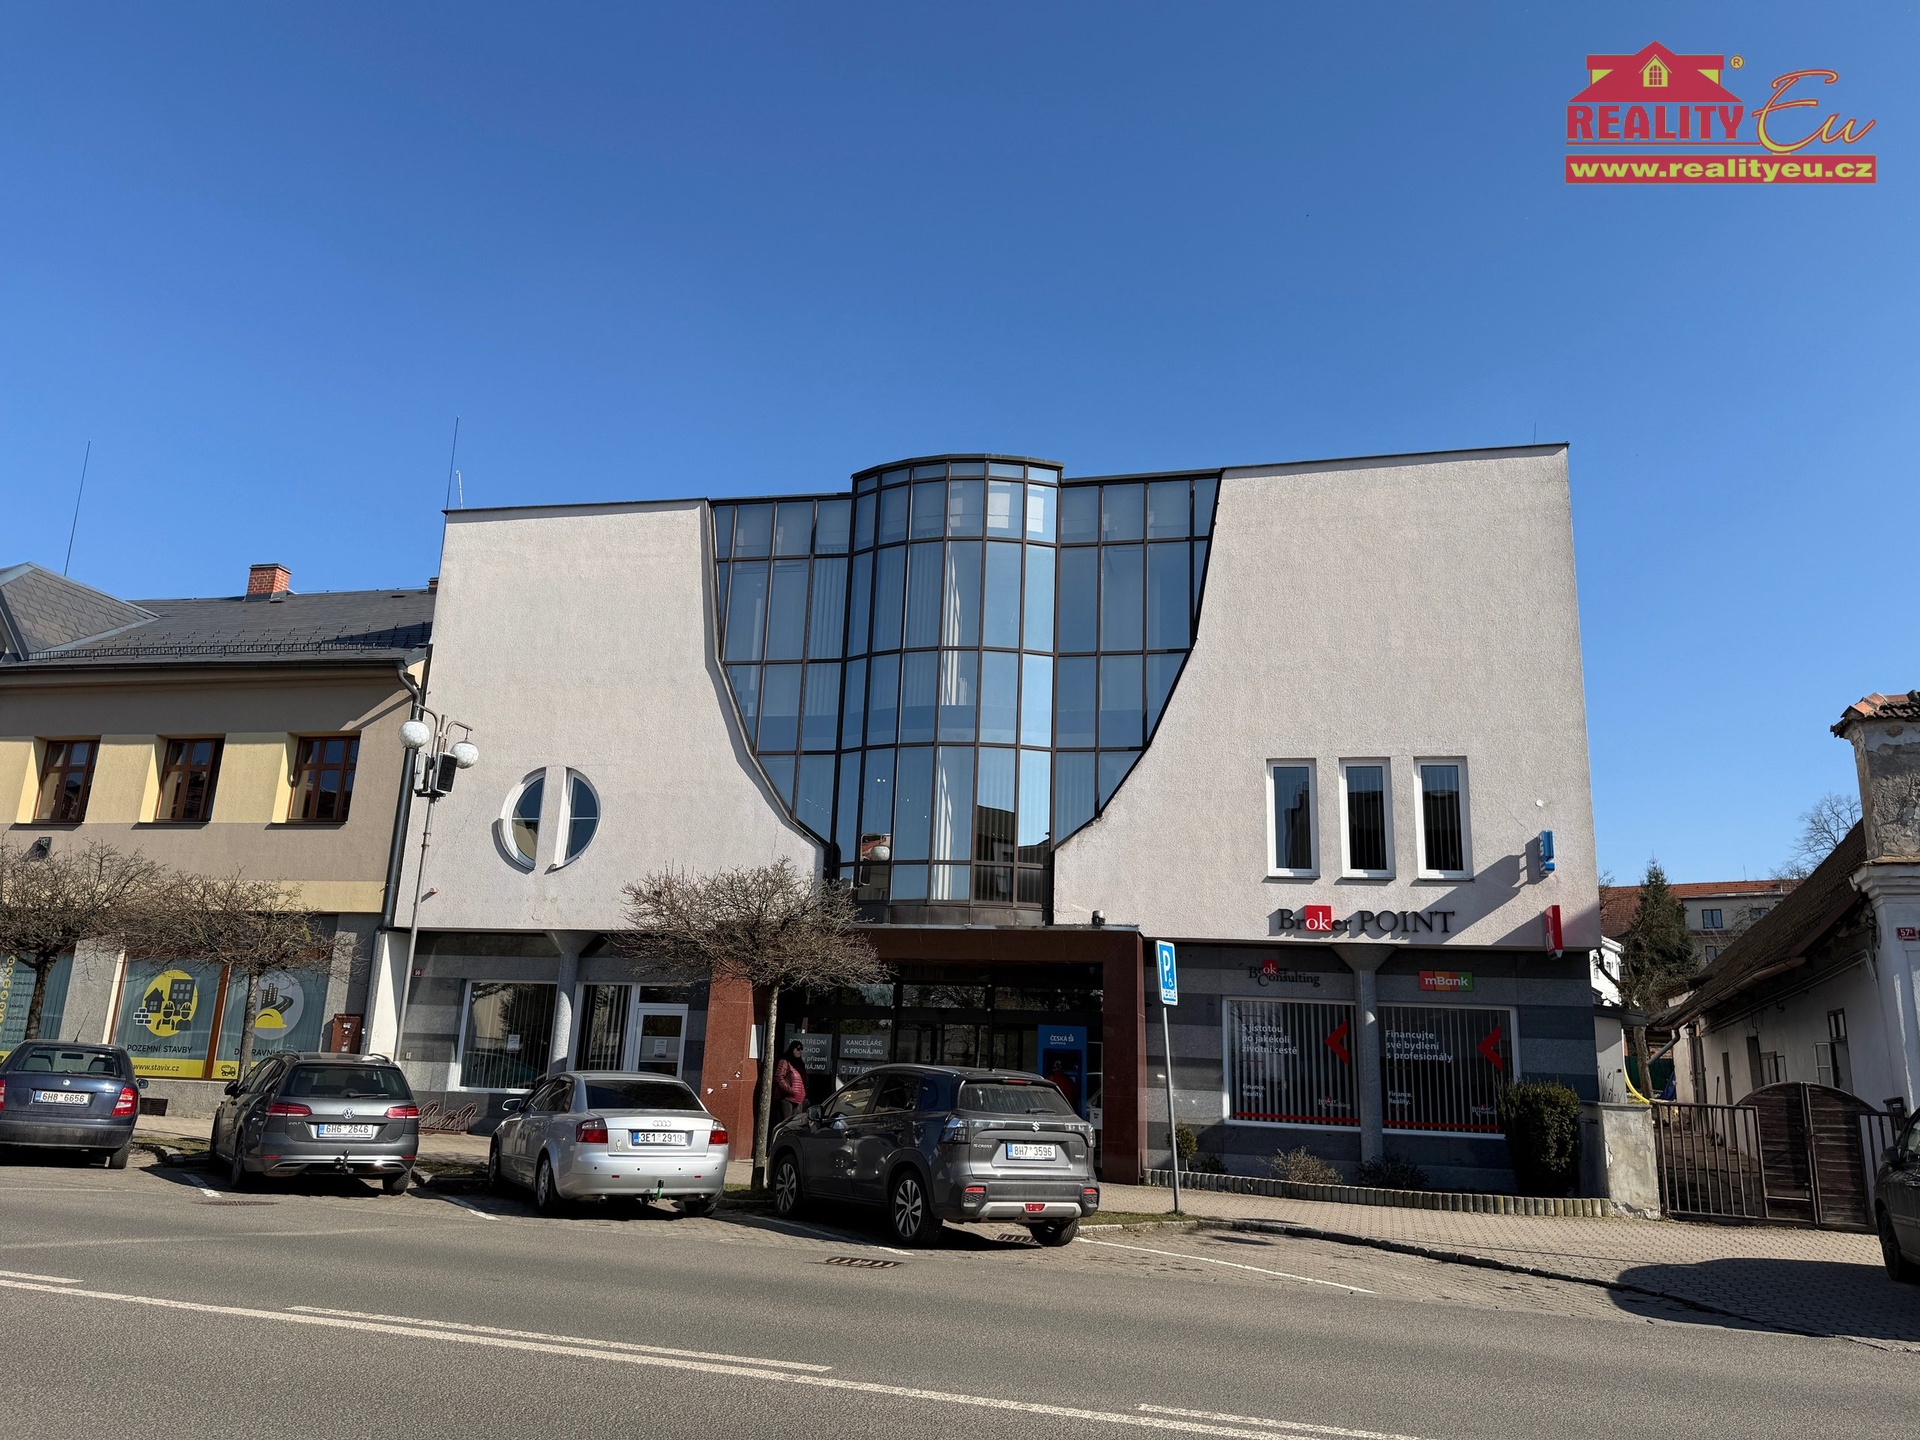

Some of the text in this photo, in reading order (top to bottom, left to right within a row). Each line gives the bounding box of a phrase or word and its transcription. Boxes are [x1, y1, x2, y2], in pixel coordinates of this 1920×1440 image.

[1278, 908, 1455, 933] Broker POINT
[1248, 963, 1289, 978] Broker
[1257, 970, 1320, 987] Consulting
[1424, 976, 1468, 986] mBank
[1241, 1023, 1283, 1033] S jistotou
[1255, 1035, 1290, 1044] jakékoli
[1385, 1030, 1435, 1040] Financujte
[789, 1038, 827, 1046] PSTŘEDNÍ
[1386, 1041, 1439, 1051] své bydlení
[127, 1044, 193, 1053] POZEMNÍ STAVBY
[234, 1048, 277, 1056] DRAVNÍ
[850, 1047, 884, 1055] PRONÁJMU
[1242, 1044, 1298, 1054] životní cestě
[1394, 1052, 1453, 1063] profesionály
[133, 1063, 180, 1072] www.stavix.cz
[805, 1062, 826, 1070] NÁJMU
[42, 1092, 59, 1101] 6H8
[326, 1124, 369, 1134] 6H6 2646
[640, 1133, 656, 1142] 3E1
[1014, 1145, 1053, 1157] 8H7 3596
